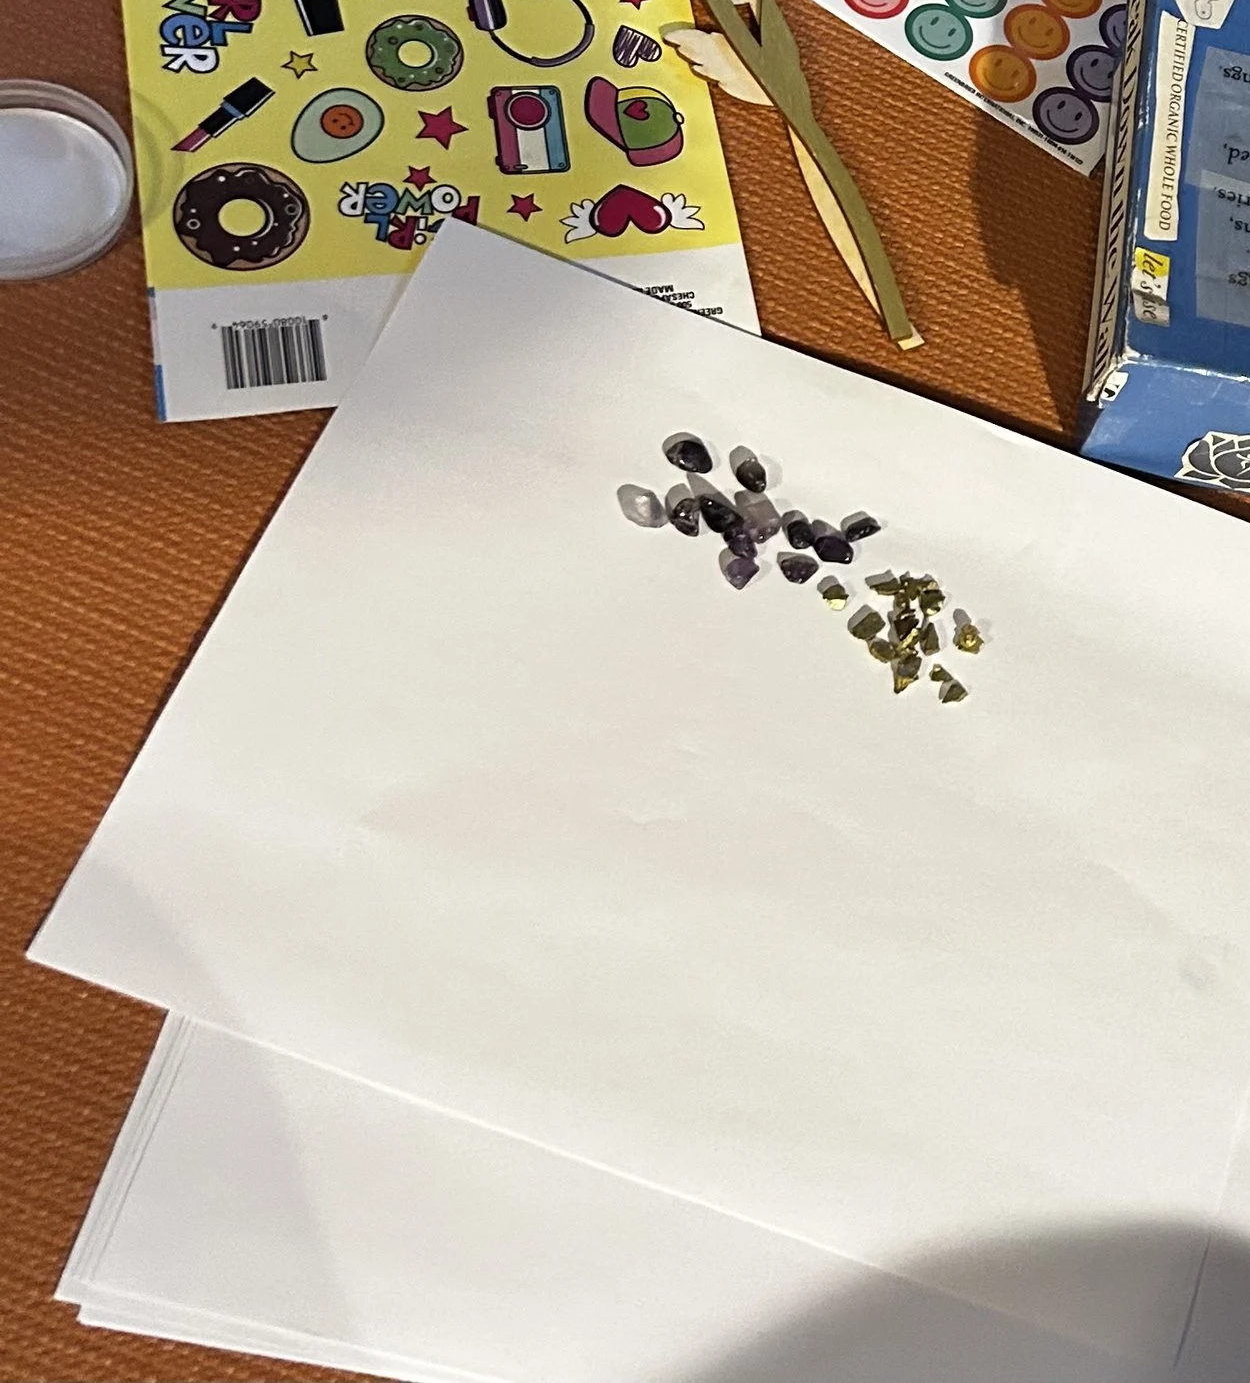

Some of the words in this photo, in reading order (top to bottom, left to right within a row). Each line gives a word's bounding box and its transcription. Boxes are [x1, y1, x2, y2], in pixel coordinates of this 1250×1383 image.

[1171, 18, 1189, 81] CERTIFIED
[1164, 83, 1184, 143] ORGANIC
[1161, 144, 1178, 191] WHOLE
[1158, 192, 1173, 231] FOOD
[1140, 252, 1164, 295] let's
